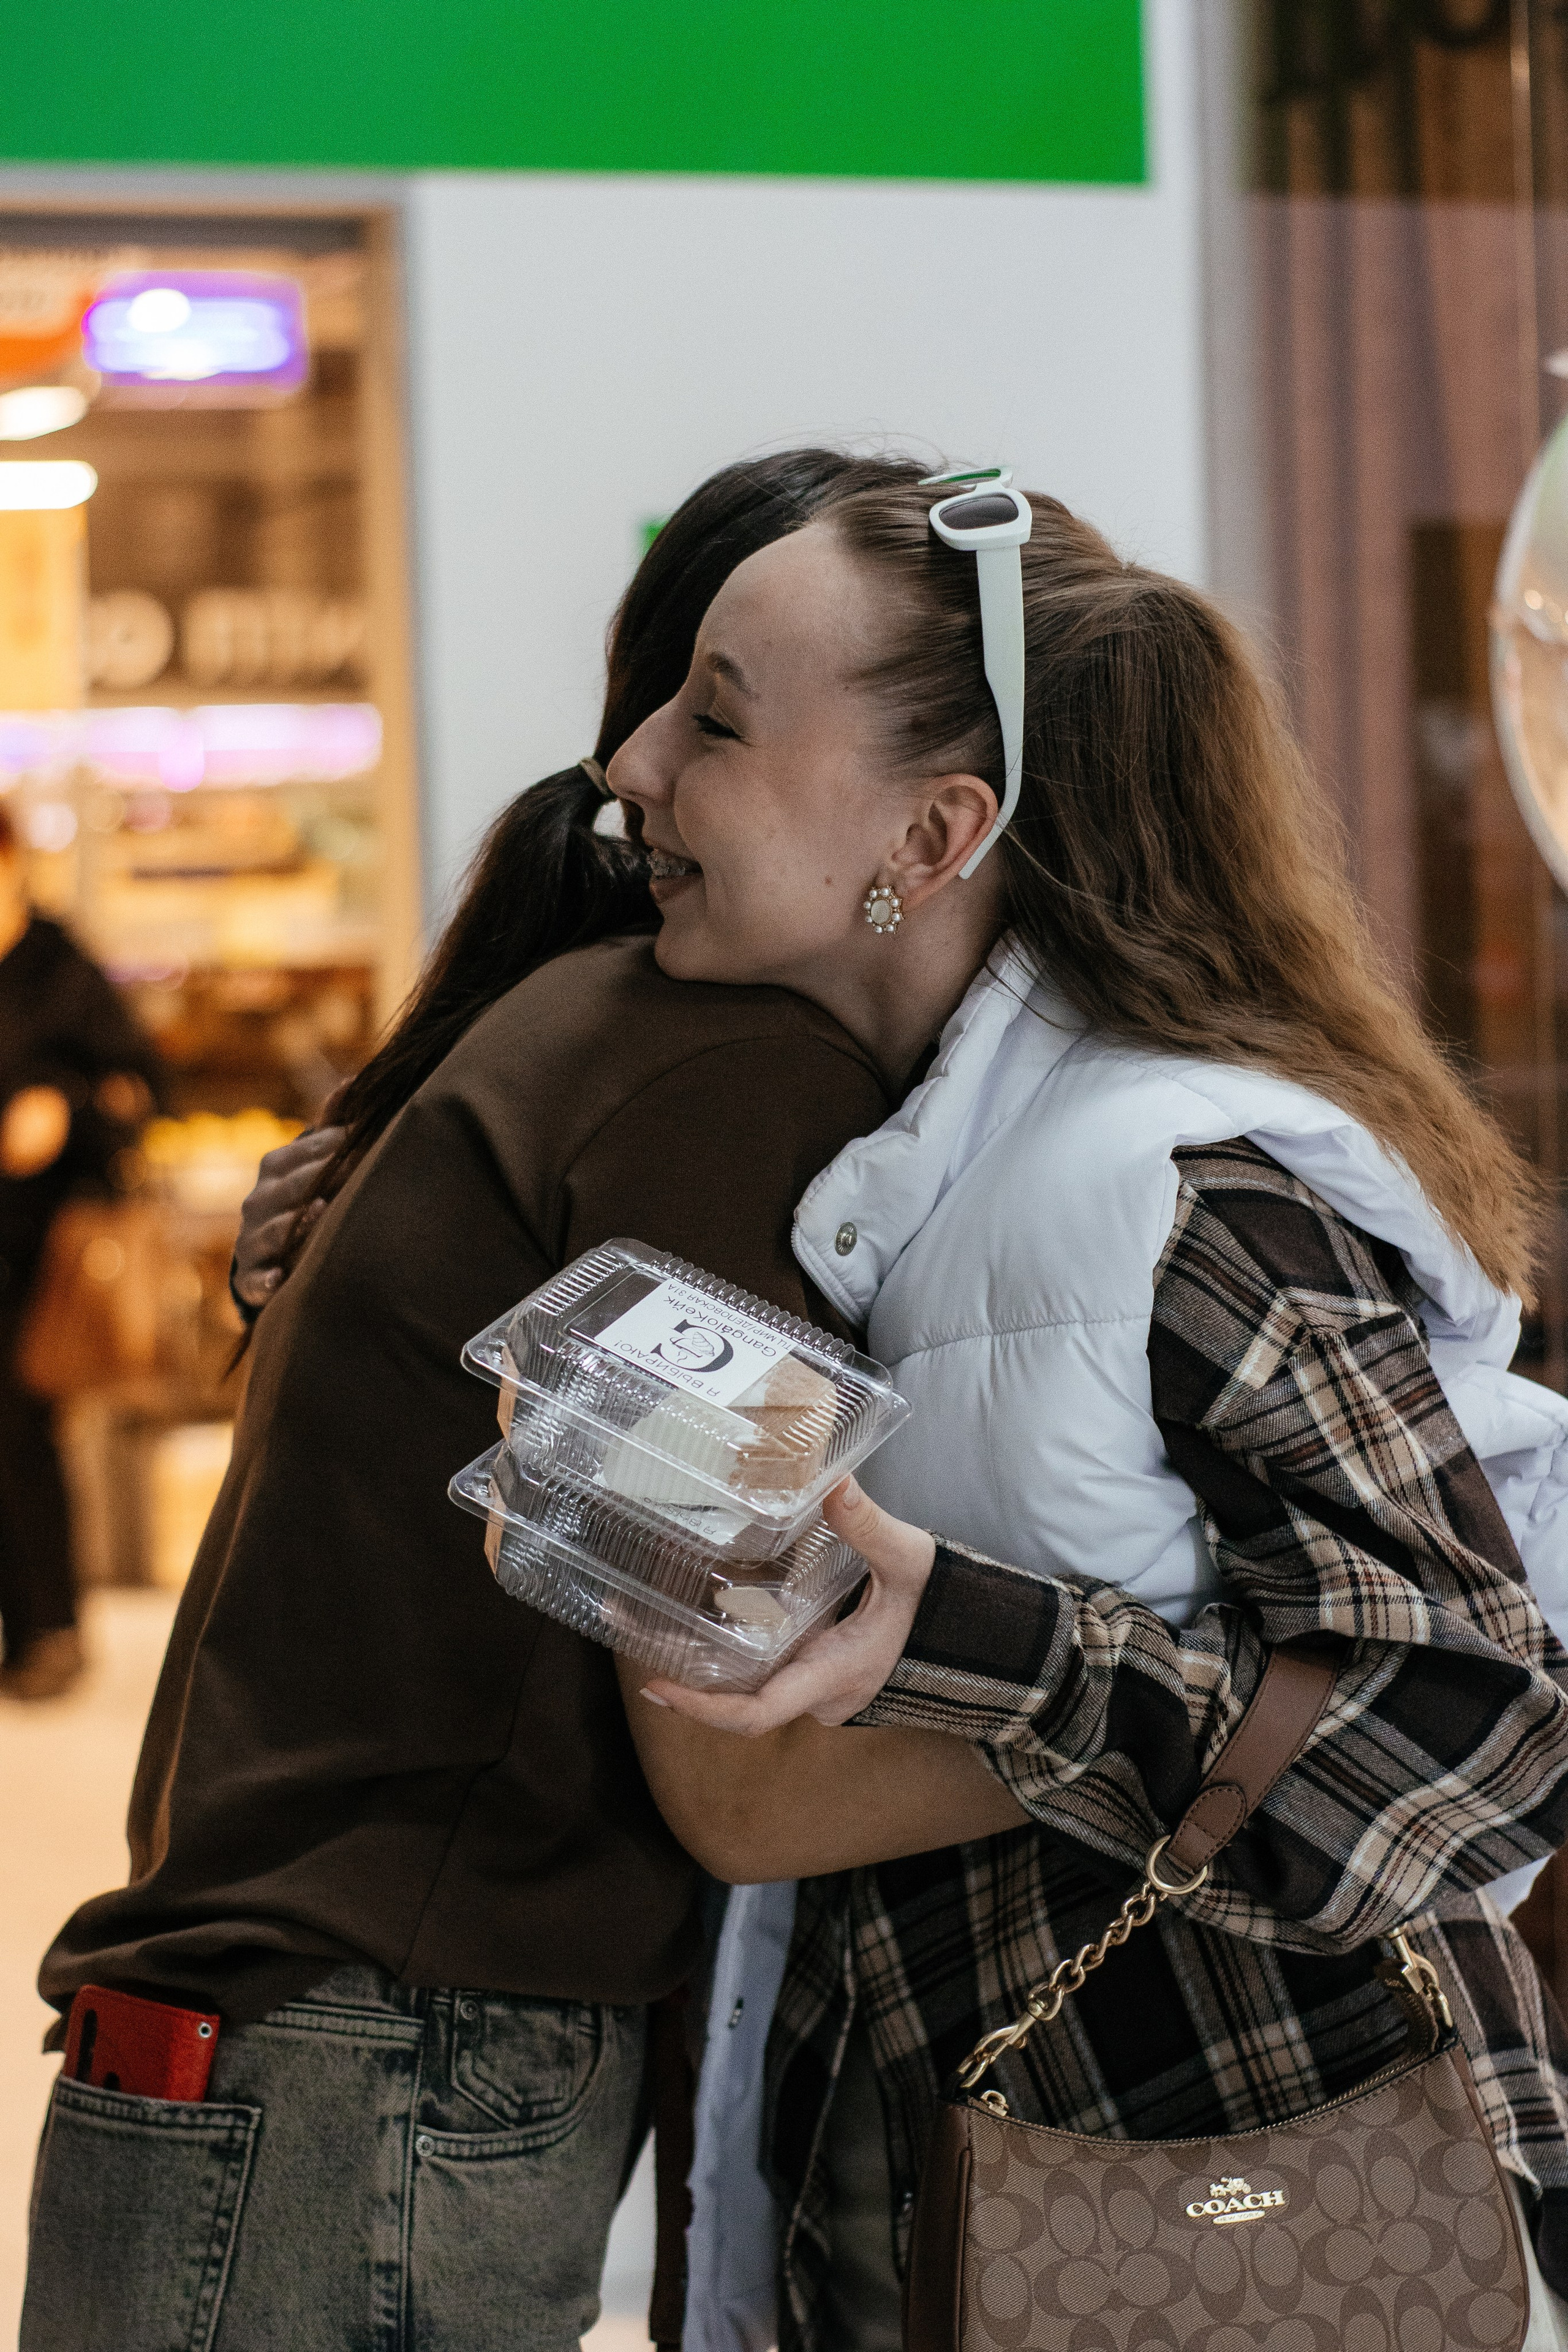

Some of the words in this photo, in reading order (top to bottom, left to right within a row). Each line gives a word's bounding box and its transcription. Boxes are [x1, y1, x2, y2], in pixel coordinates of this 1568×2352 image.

[687, 1294, 776, 1342] МИР/ДЕПОВСКАЯ
[777, 1338, 792, 1351] ТЦ
[614, 1340, 704, 1389] ВЫБИРАЮ!
[707, 1387, 720, 1397] Я
[1186, 2190, 1285, 2218] COACH
